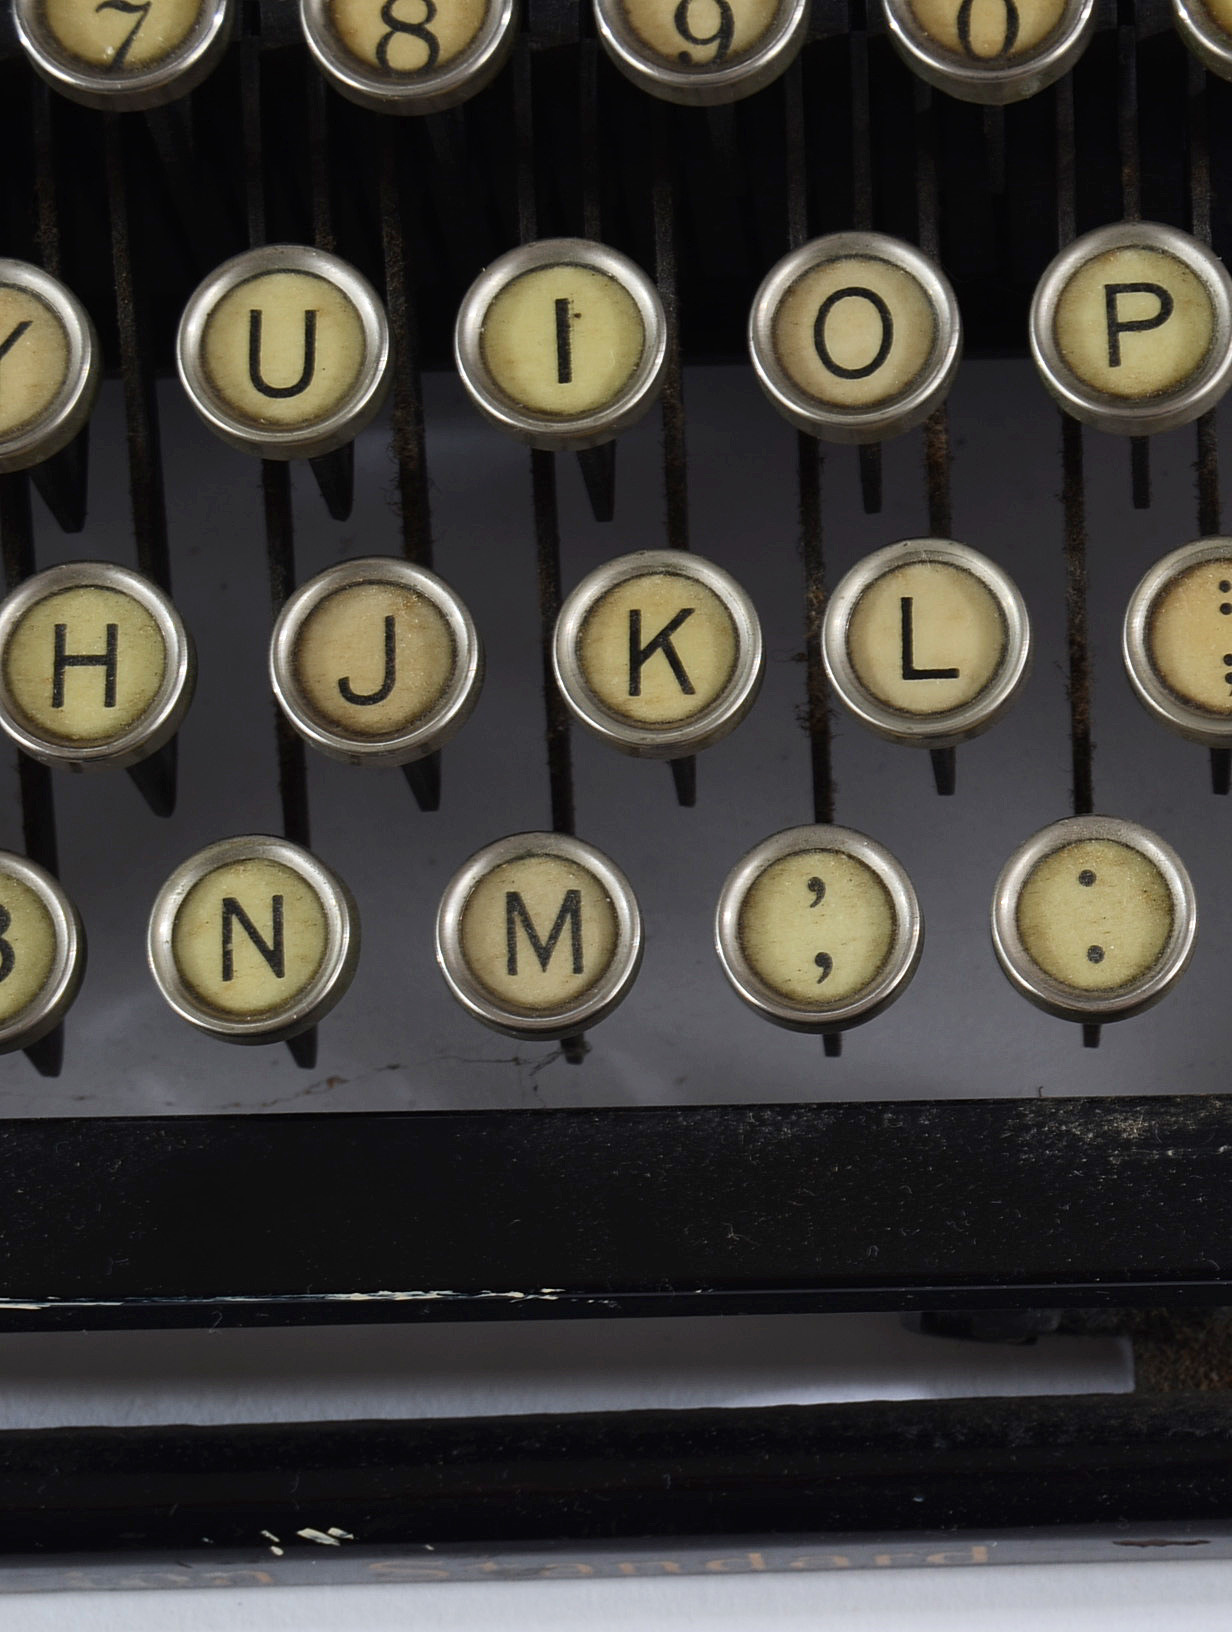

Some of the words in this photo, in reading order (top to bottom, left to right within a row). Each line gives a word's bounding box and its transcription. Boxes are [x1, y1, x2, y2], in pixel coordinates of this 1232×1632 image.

[95, 0, 152, 70] 7
[376, 0, 441, 73] 8
[673, 0, 735, 65] 9
[249, 309, 317, 398] U
[555, 298, 573, 384] I
[814, 287, 893, 379] O
[1104, 282, 1174, 367] P
[50, 624, 118, 709] H
[338, 615, 396, 706] J
[629, 608, 695, 696] K
[901, 597, 959, 680] L
[222, 895, 285, 981] N
[506, 889, 584, 976] M
